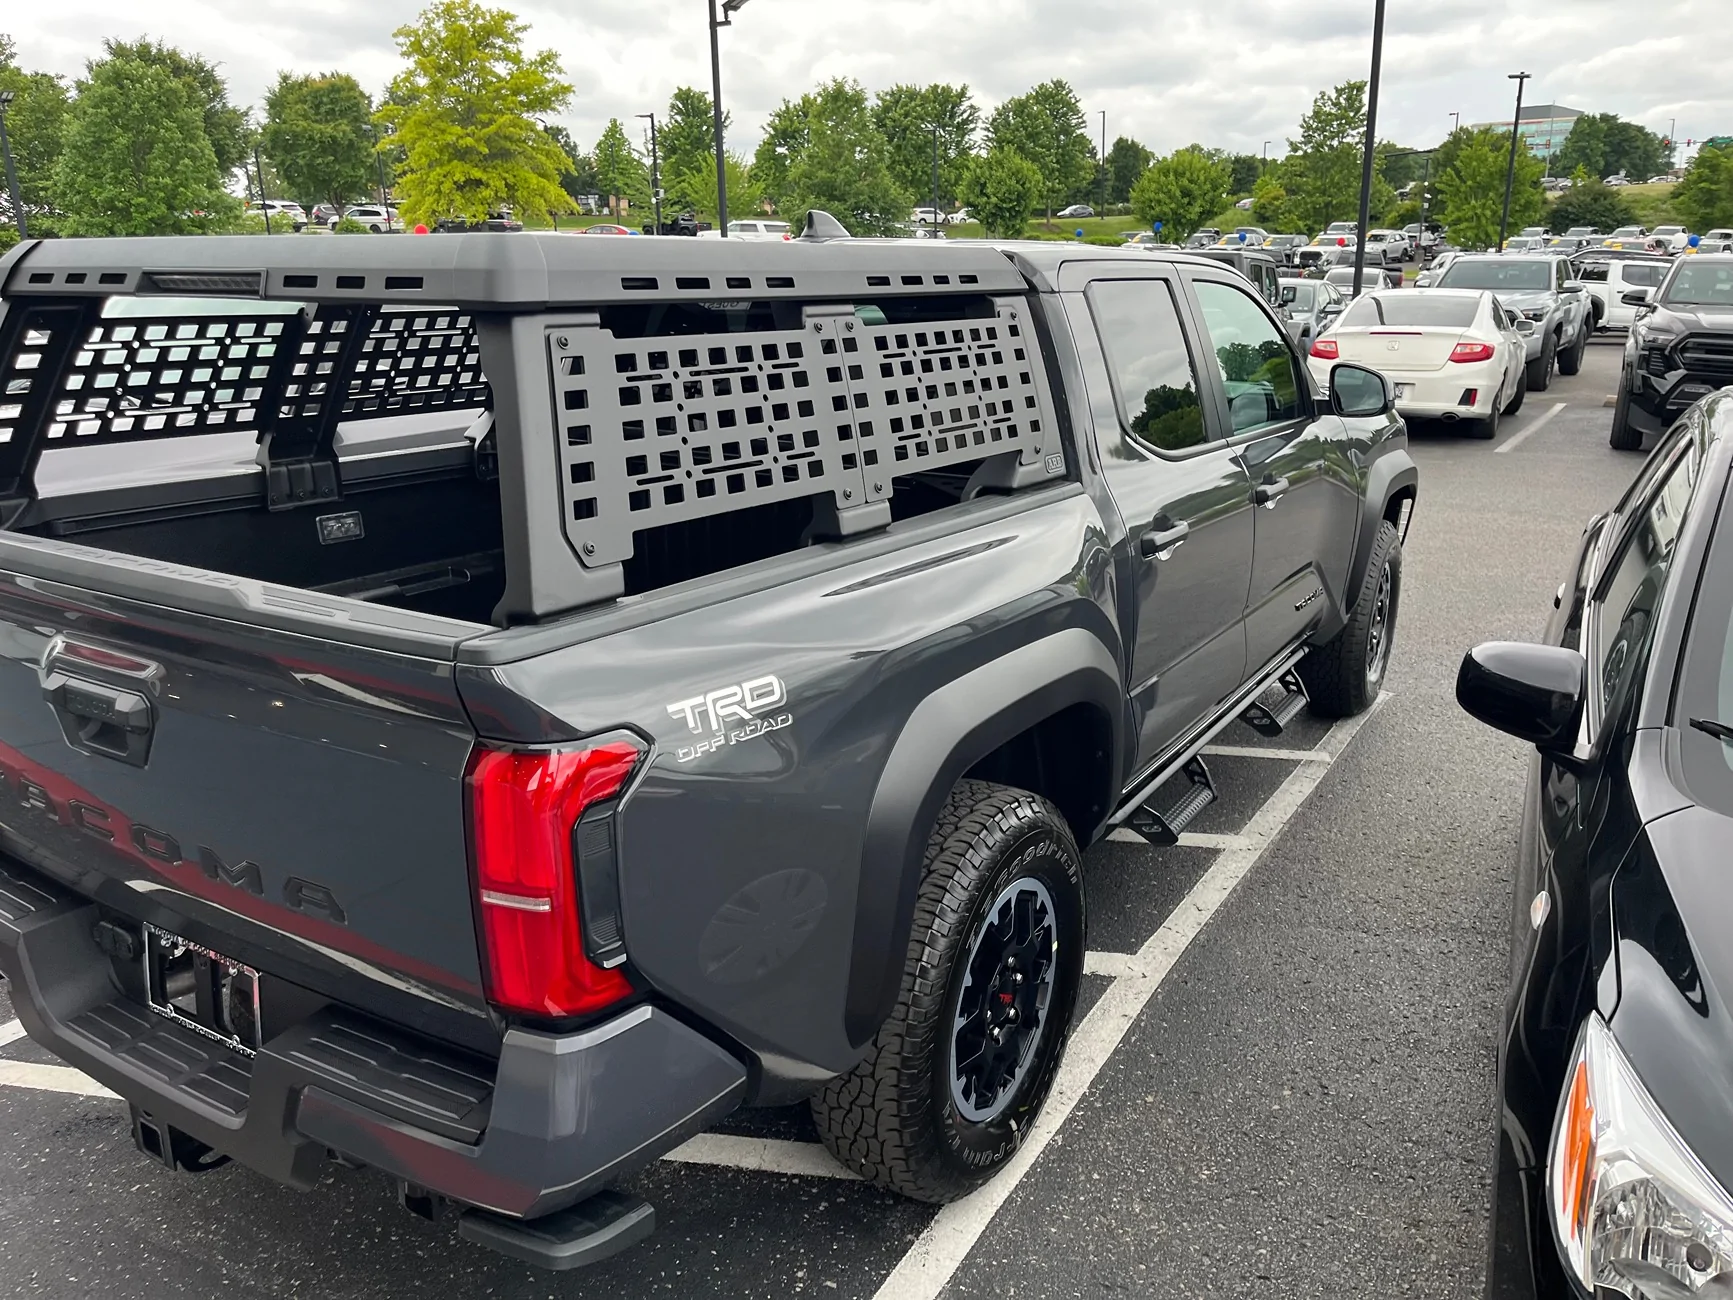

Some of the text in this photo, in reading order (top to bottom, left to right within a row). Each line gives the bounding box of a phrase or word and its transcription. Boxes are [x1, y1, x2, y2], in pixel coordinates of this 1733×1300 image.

[1046, 455, 1063, 471] ARB
[666, 674, 787, 735] TRD
[676, 713, 793, 763] OFF ROAD
[0, 768, 348, 925] ACOMA
